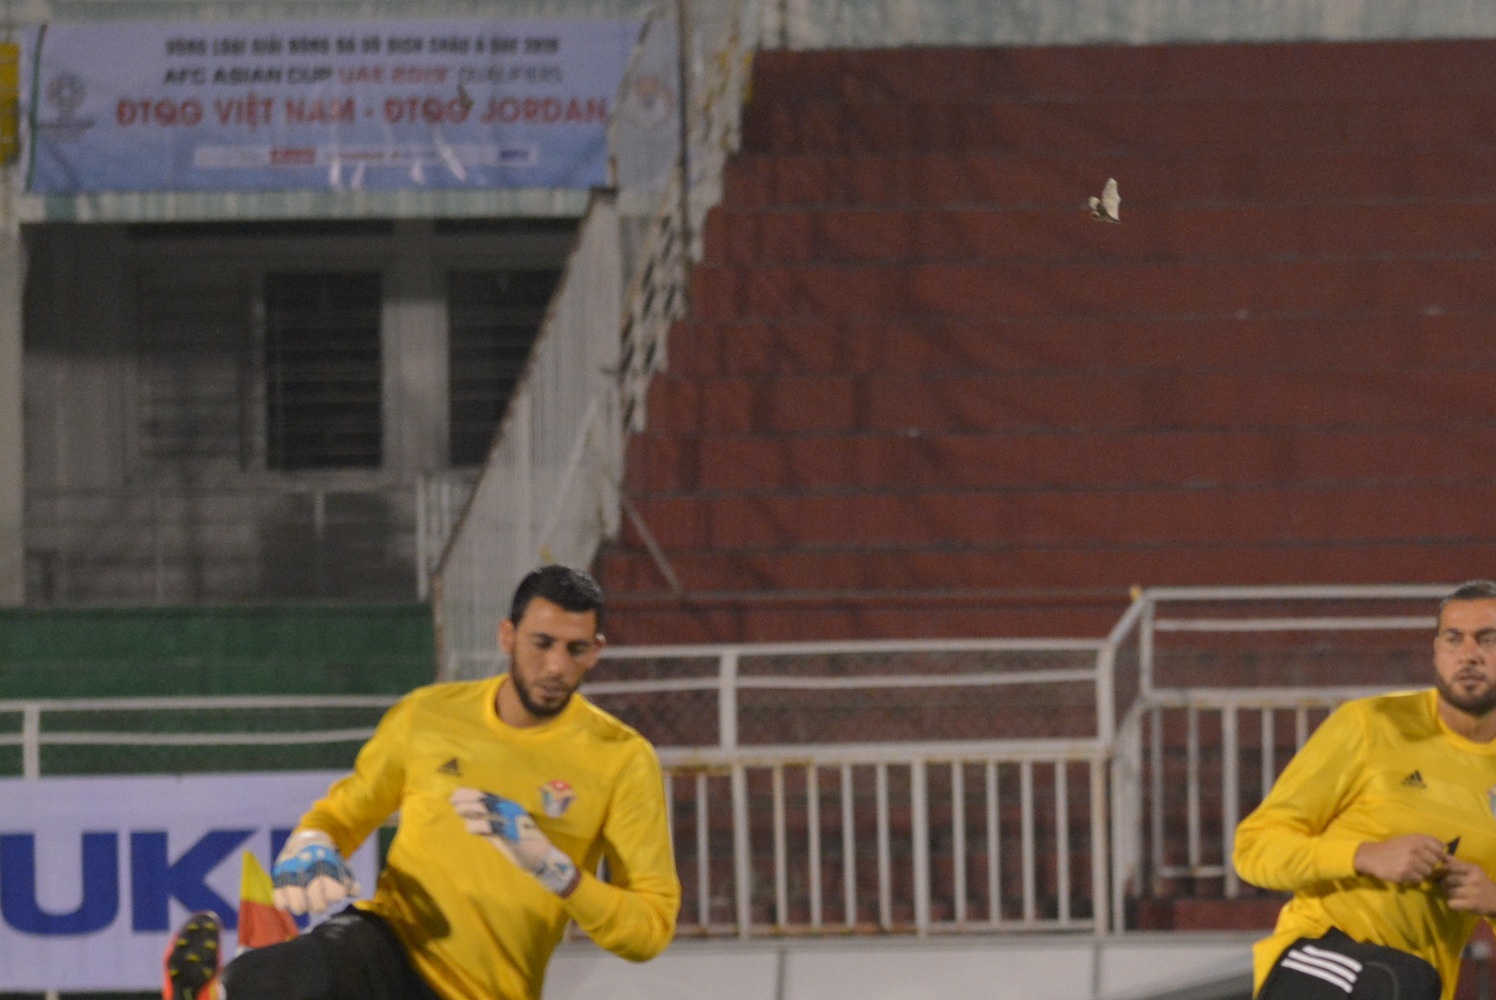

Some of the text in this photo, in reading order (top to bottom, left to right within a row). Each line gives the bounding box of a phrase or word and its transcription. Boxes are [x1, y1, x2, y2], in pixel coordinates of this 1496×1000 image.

[213, 67, 282, 84] ASIAN
[287, 66, 331, 84] CUP
[480, 96, 607, 125] JORDAN
